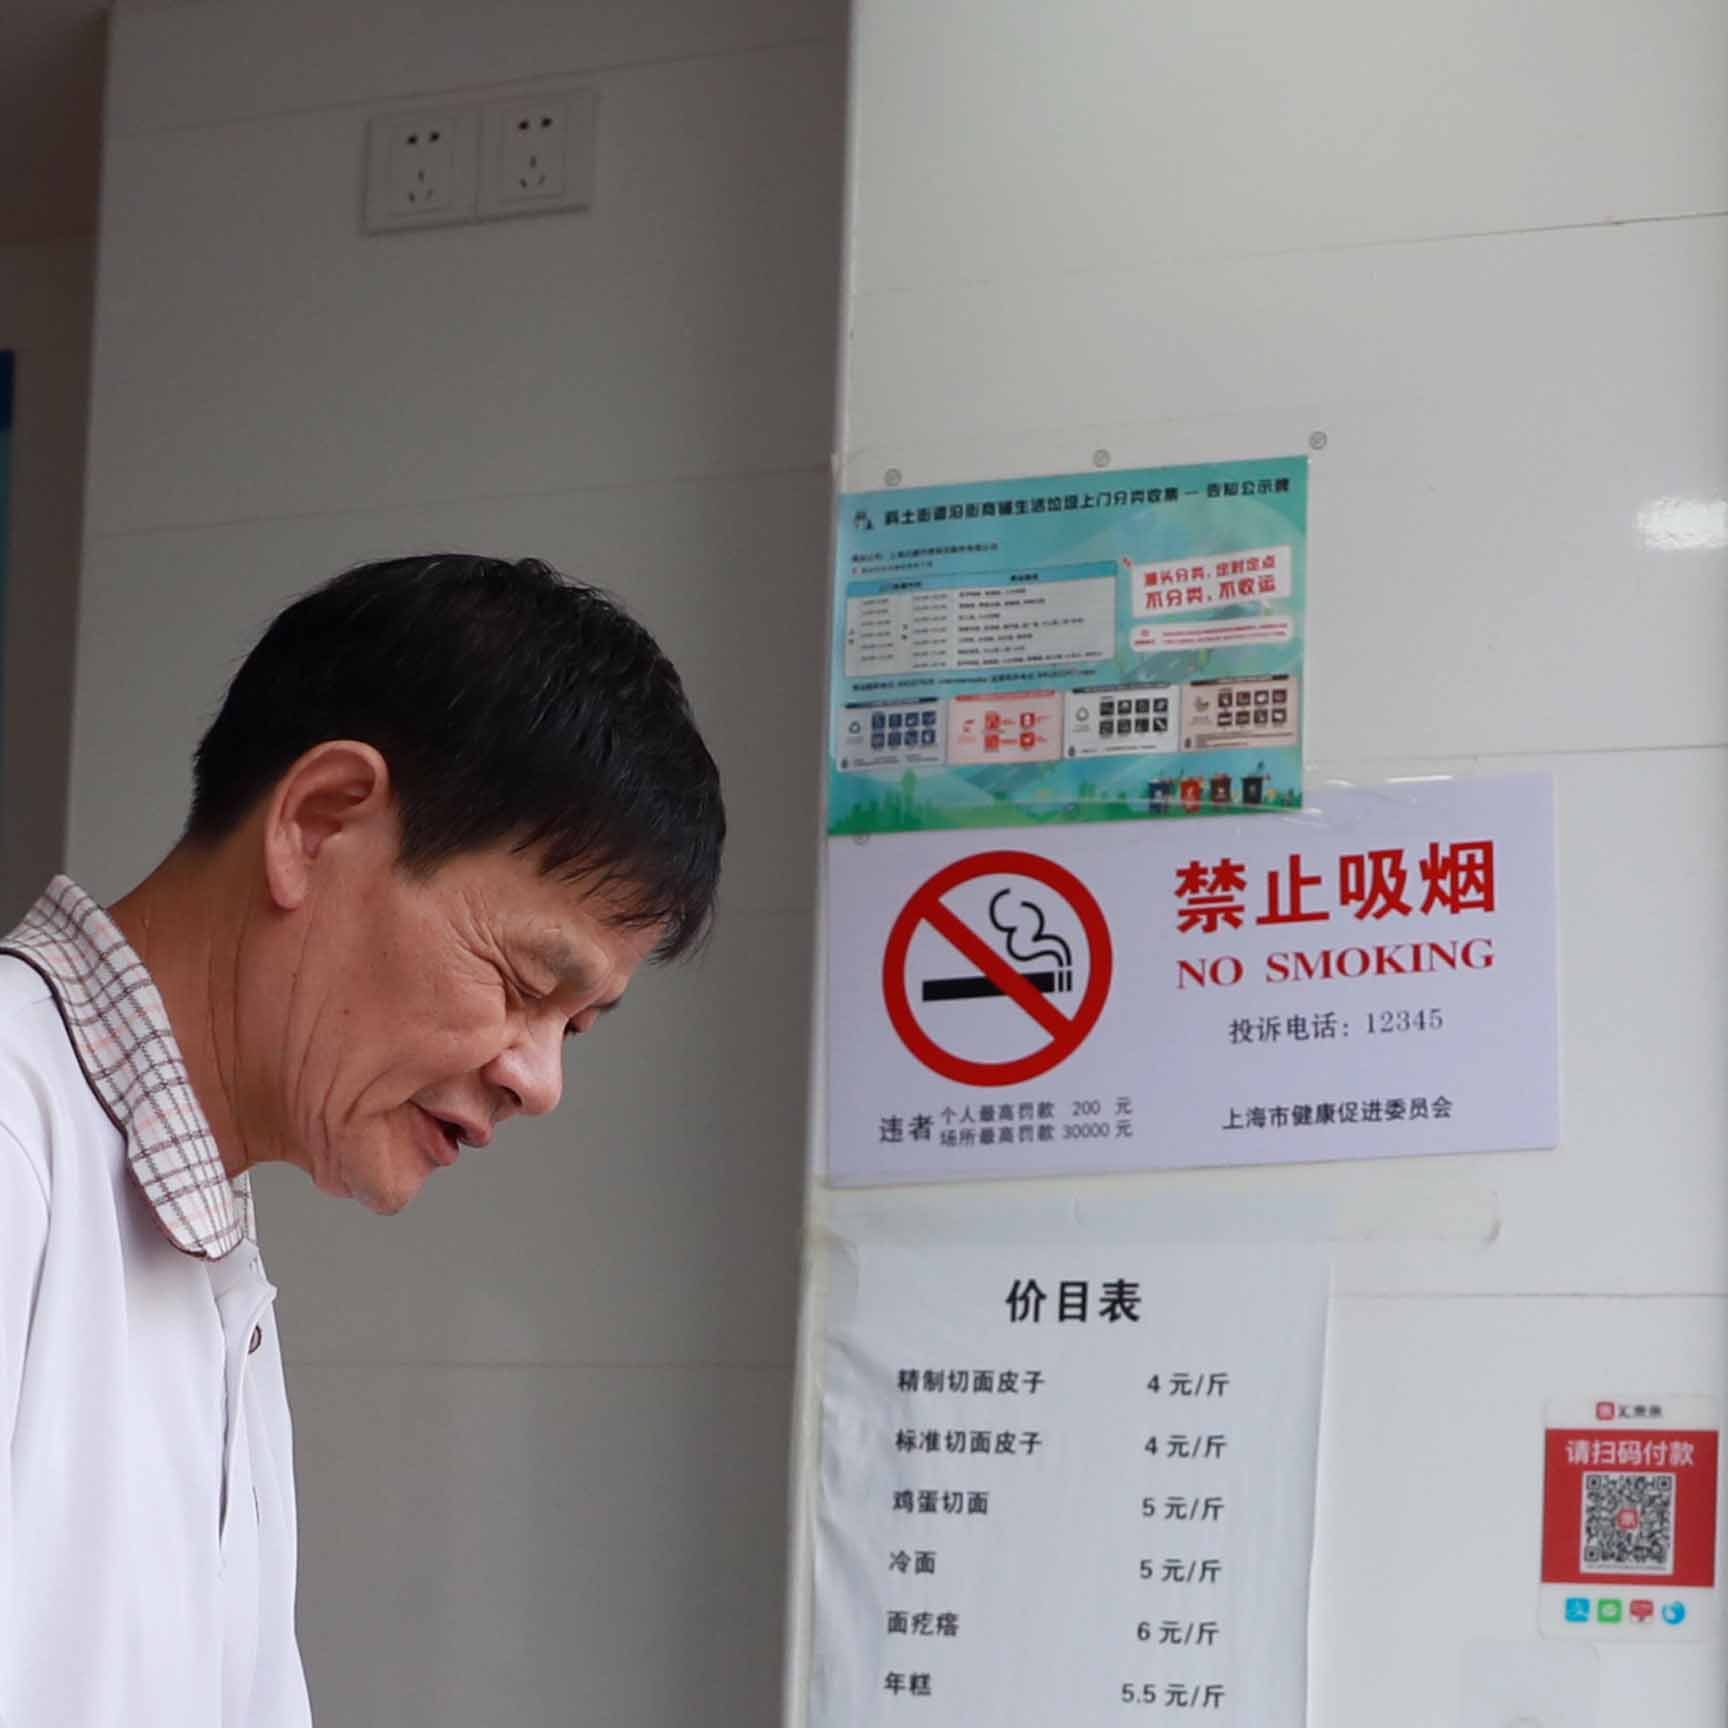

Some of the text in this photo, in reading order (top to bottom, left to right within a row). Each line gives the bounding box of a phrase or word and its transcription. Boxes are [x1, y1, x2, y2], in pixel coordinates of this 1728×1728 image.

[1175, 841, 1494, 933] 禁止吸烟
[1178, 940, 1492, 988] NO SMOKING
[942, 1097, 1132, 1125] 个人最高罚款 200 元
[1222, 1096, 1451, 1129] 上海市健康促进委员会
[880, 1114, 933, 1142] 违者
[940, 1120, 1132, 1147] 场所最高罚款 30000 元
[1006, 1279, 1141, 1322] 价目表
[897, 1369, 1044, 1394] 精制切面皮子
[895, 1429, 1041, 1454] 标准切面皮子
[1566, 1440, 1694, 1466] 请扫码付款
[893, 1489, 988, 1515] 鸡蛋切面
[890, 1550, 935, 1574] 冷面
[885, 1672, 931, 1696] 年糕
